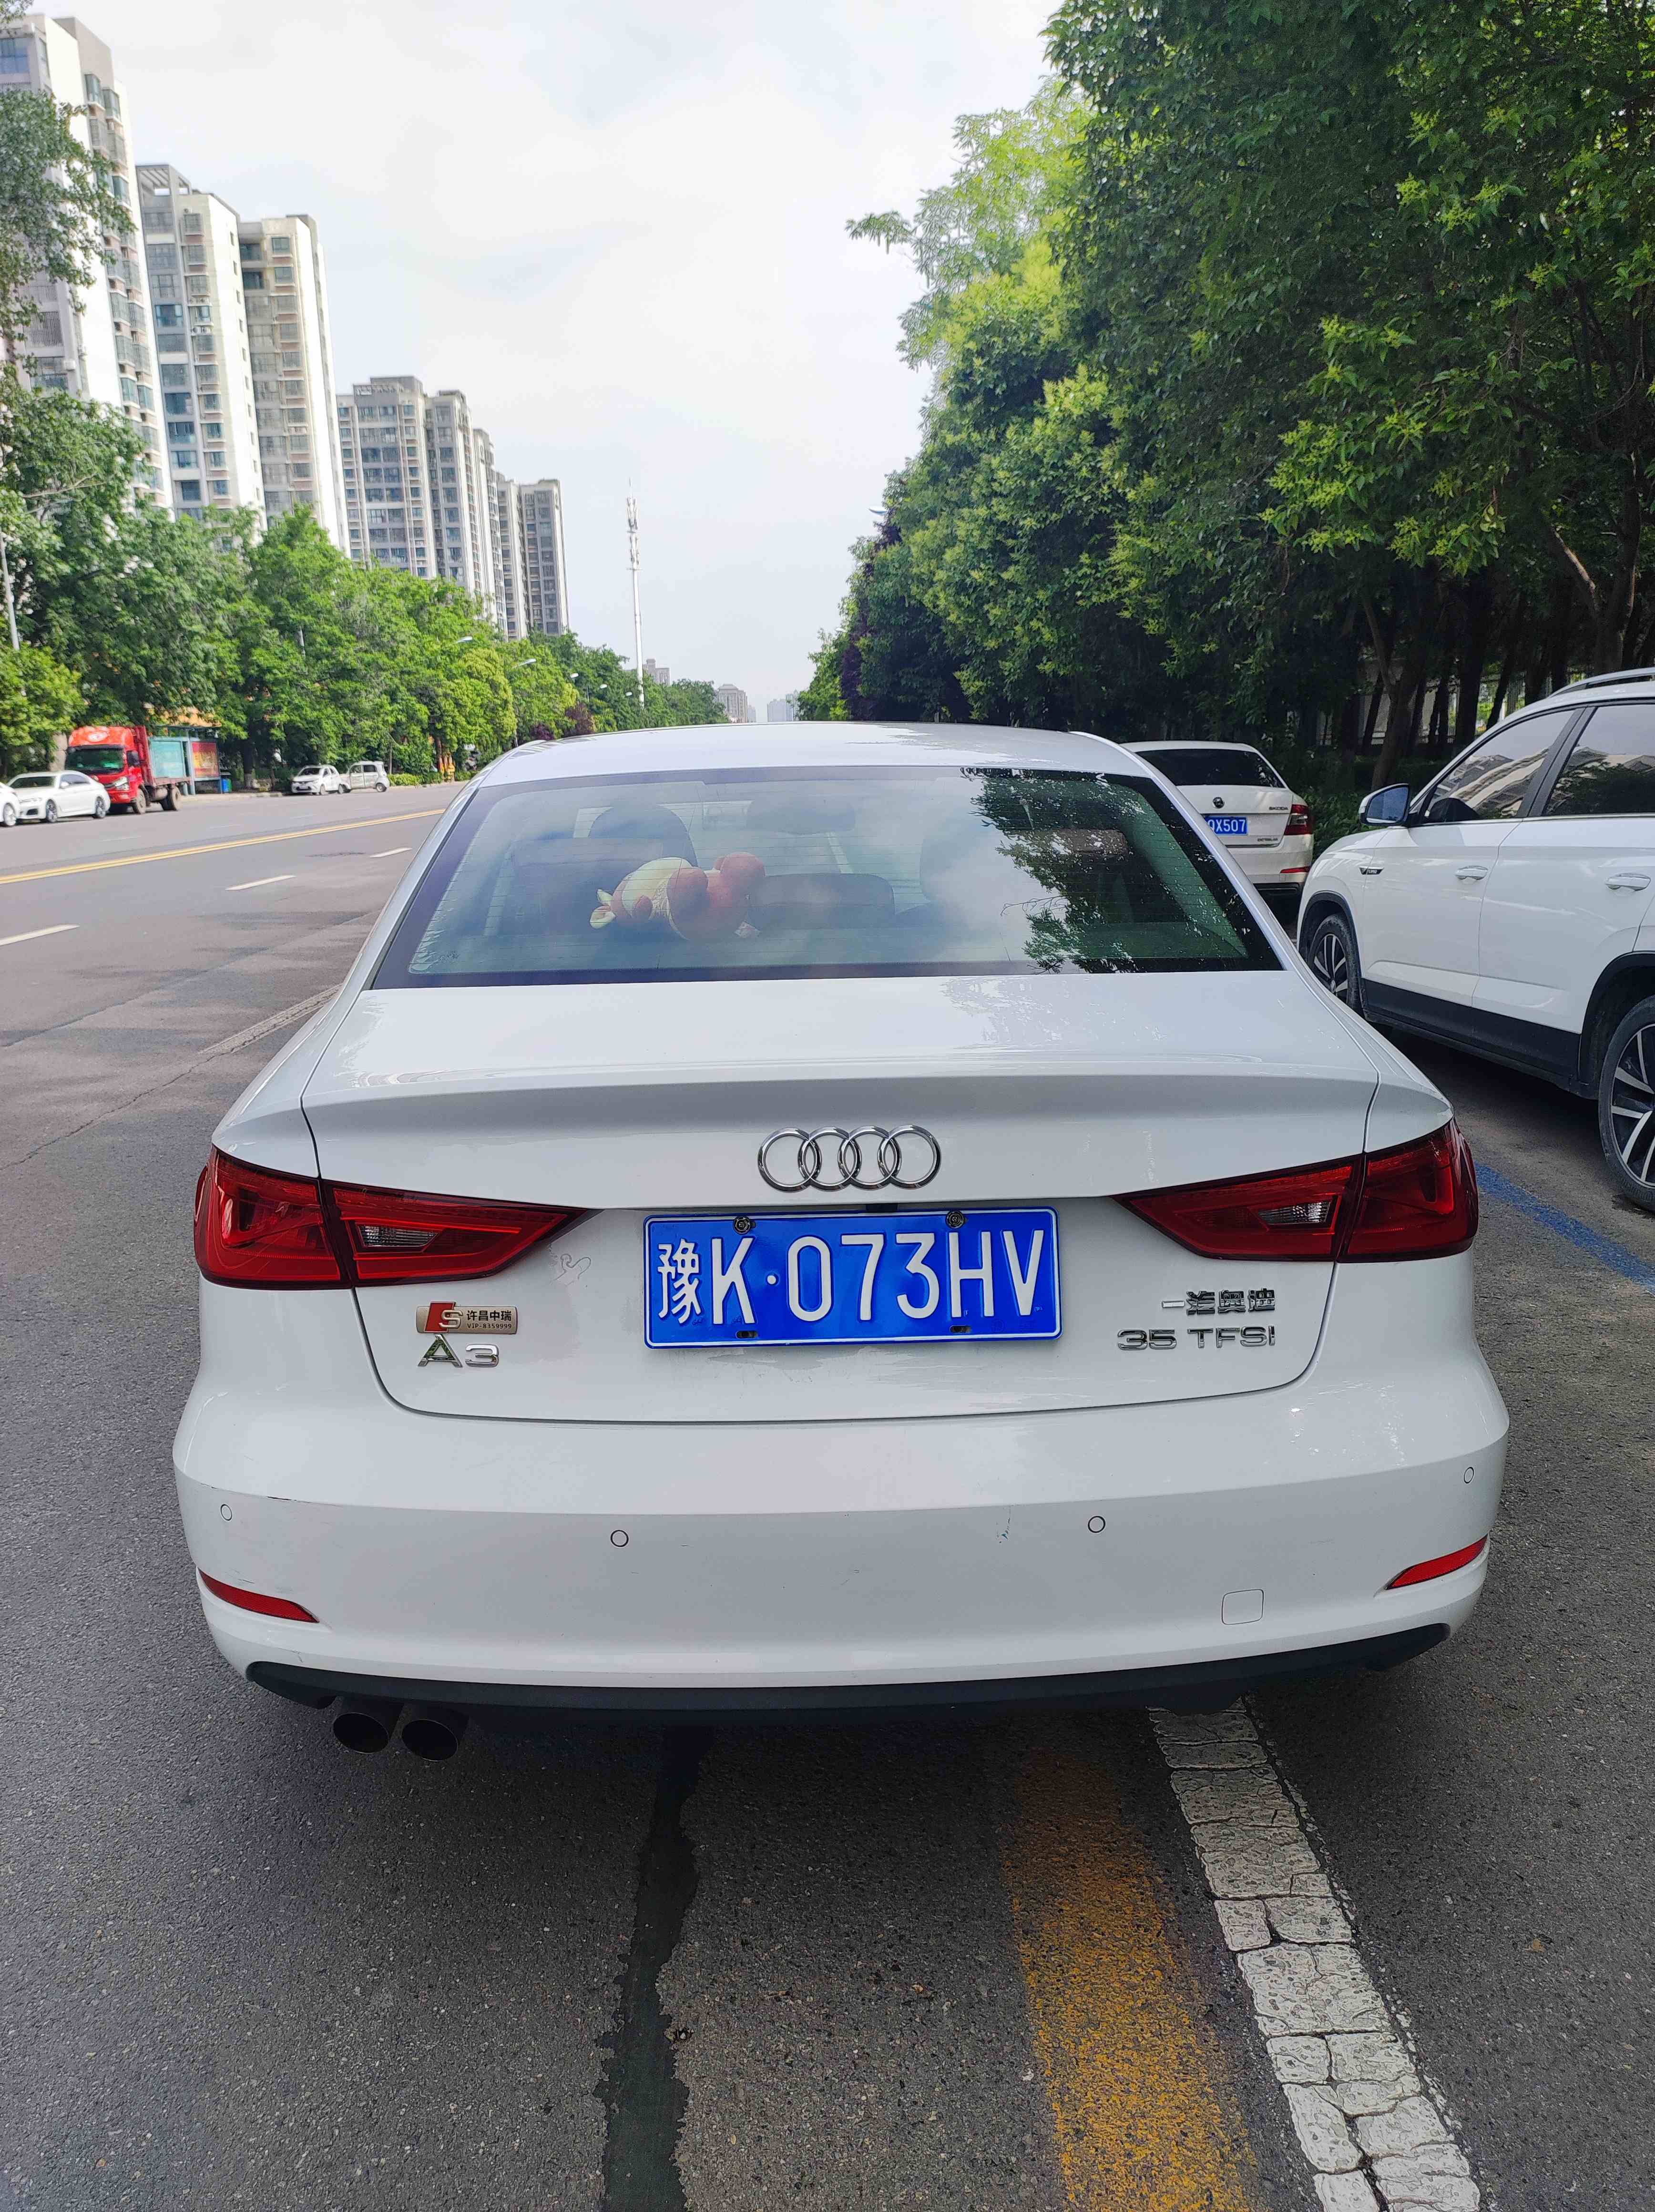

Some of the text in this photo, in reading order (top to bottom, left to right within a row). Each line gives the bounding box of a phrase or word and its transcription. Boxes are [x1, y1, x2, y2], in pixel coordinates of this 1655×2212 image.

[467, 1310, 512, 1321] 许昌中瑞
[1162, 1288, 1276, 1316] 一汽奥迪
[418, 1333, 500, 1368] A3
[1117, 1324, 1276, 1351] 35 TFSI
